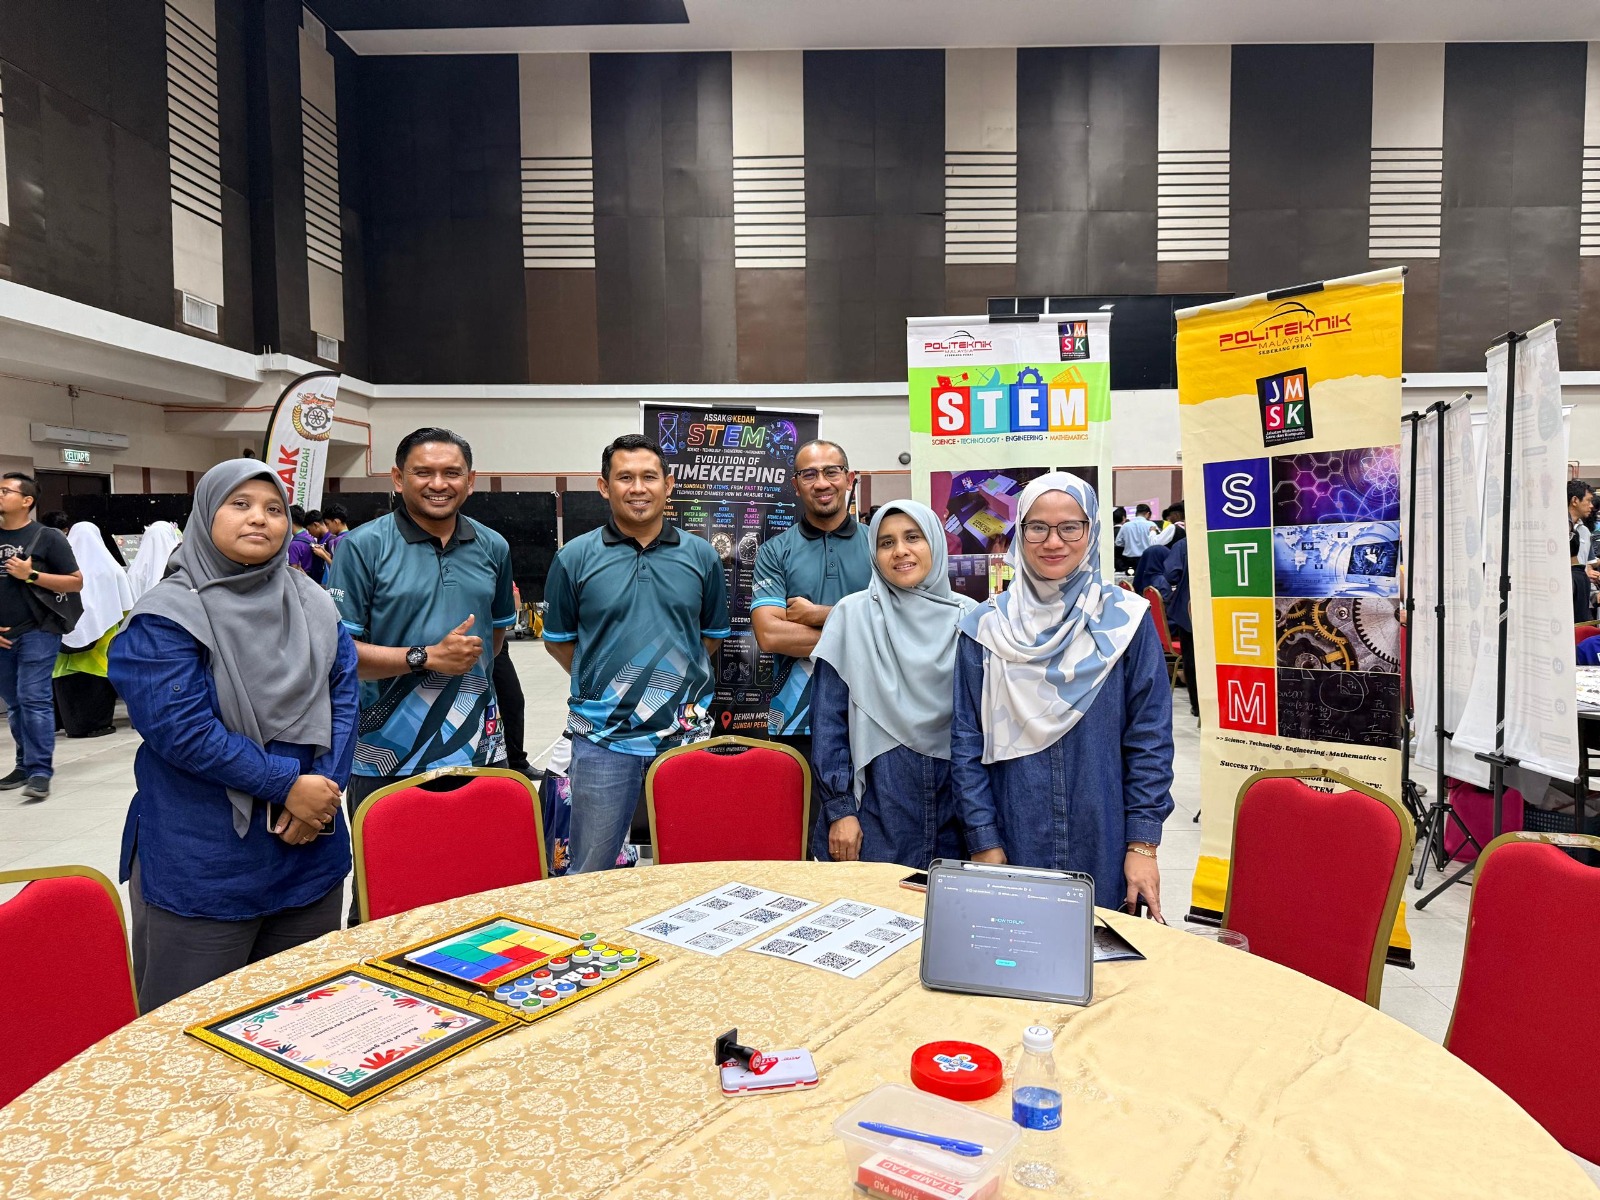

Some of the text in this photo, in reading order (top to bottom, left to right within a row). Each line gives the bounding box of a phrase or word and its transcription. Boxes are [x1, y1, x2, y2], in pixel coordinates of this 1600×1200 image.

[1219, 312, 1352, 347] POLITEKNIK
[924, 341, 992, 350] POLITEKNIK
[1258, 335, 1312, 349] MALAYSIA
[1258, 343, 1312, 356] SEBERANG PERAI
[937, 387, 1085, 431] STEM
[704, 413, 756, 424] ASSAK@KEDAH
[687, 423, 766, 448] STEM
[931, 438, 956, 446] SCIENCE
[960, 436, 1000, 445] TECHNOLOGY
[1005, 434, 1044, 442] ENGINEERING
[299, 447, 311, 480] KEDAH
[695, 455, 760, 466] EVOLUTION OF
[668, 463, 786, 484] TIMEKEEPING
[734, 713, 755, 721] DEWAN
[732, 722, 753, 730] SUNGAI
[1224, 736, 1377, 761] Science Technology Engineering Mathematics
[1219, 760, 1248, 770] Success
[882, 1159, 958, 1194] STAMP PAD
[873, 1179, 919, 1200] STAMP PAD
